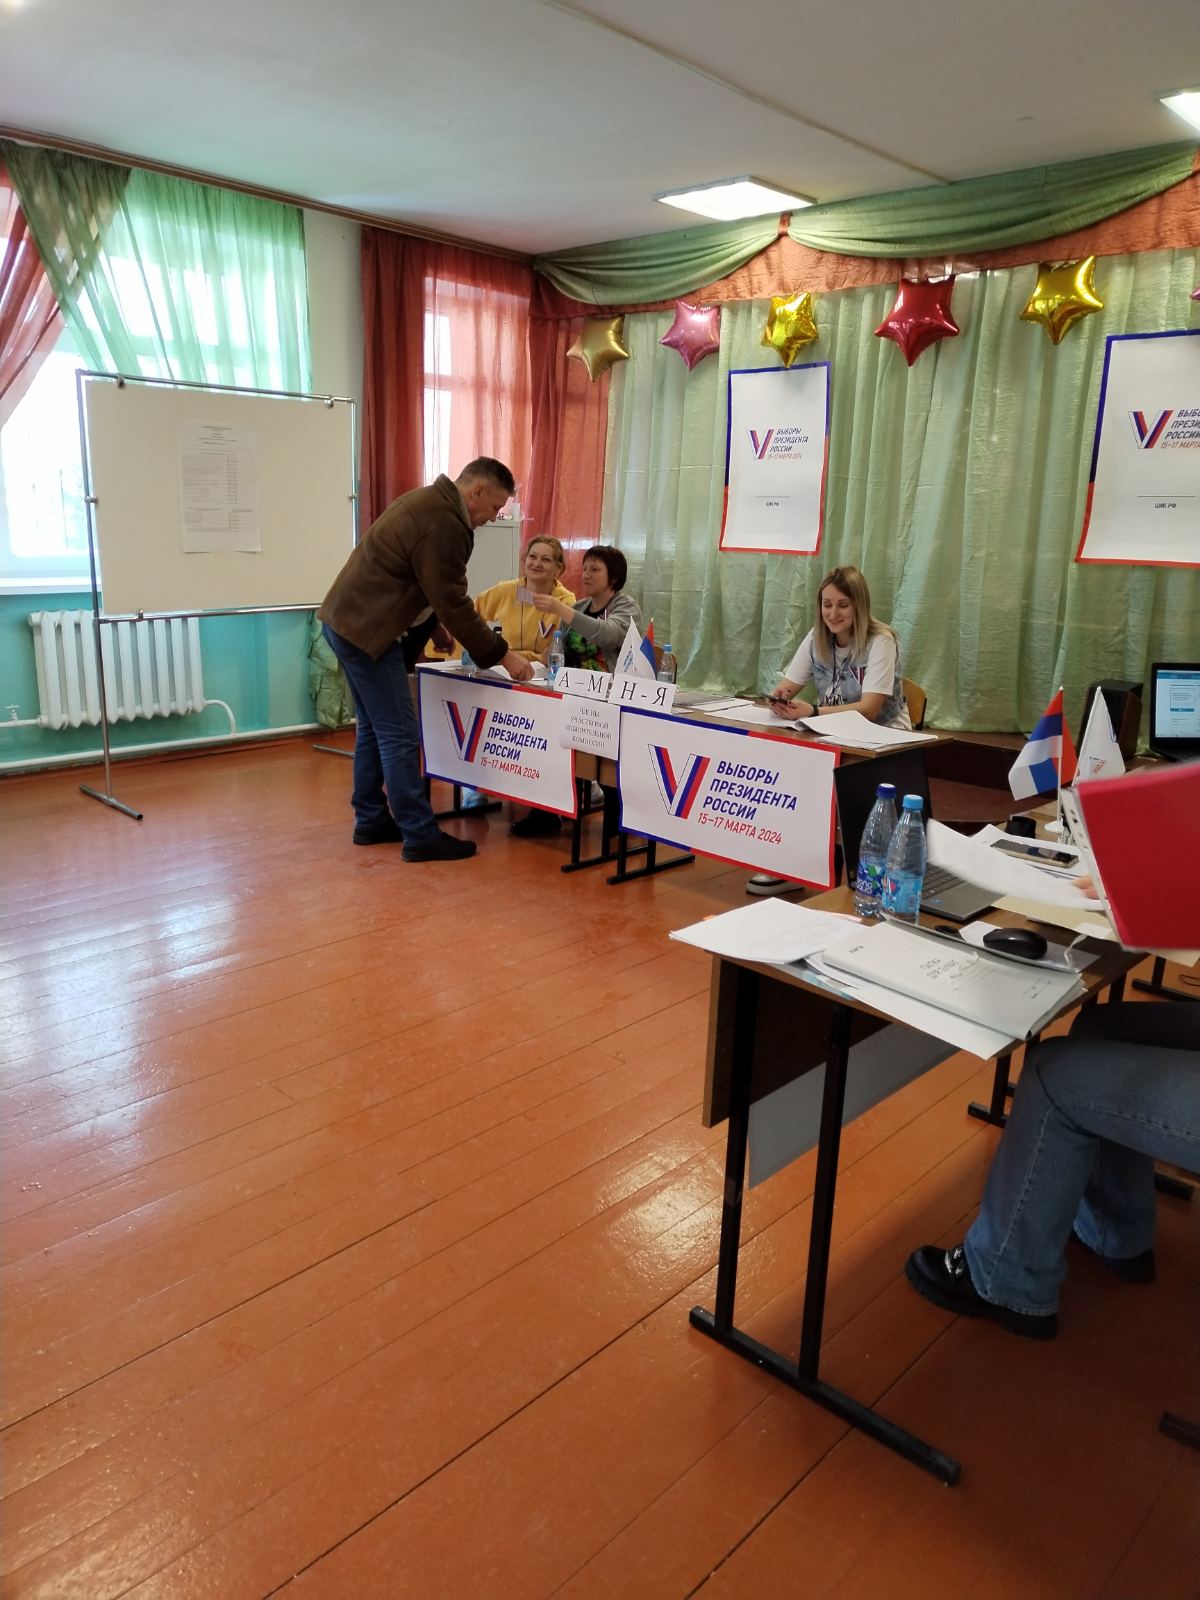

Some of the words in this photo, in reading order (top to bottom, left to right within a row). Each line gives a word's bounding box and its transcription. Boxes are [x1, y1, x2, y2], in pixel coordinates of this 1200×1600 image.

[773, 436, 809, 444] ПРЕЗИДЕНТА
[776, 427, 802, 436] ВЫБОРЫ
[769, 445, 793, 453] РОССИИ
[492, 711, 535, 731] ВЫБОРЫ
[487, 726, 548, 751] ПРЕЗИДЕНТА
[483, 742, 521, 761] РОССИИ
[499, 761, 521, 775] МАРТА
[523, 767, 540, 780] 2024
[716, 760, 780, 786] ВЫБОРЫ
[709, 778, 798, 811] ПРЕЗИДЕНТА
[702, 796, 757, 821] РОССИИ
[724, 820, 756, 838] МАРТА
[758, 828, 782, 845] 2024
